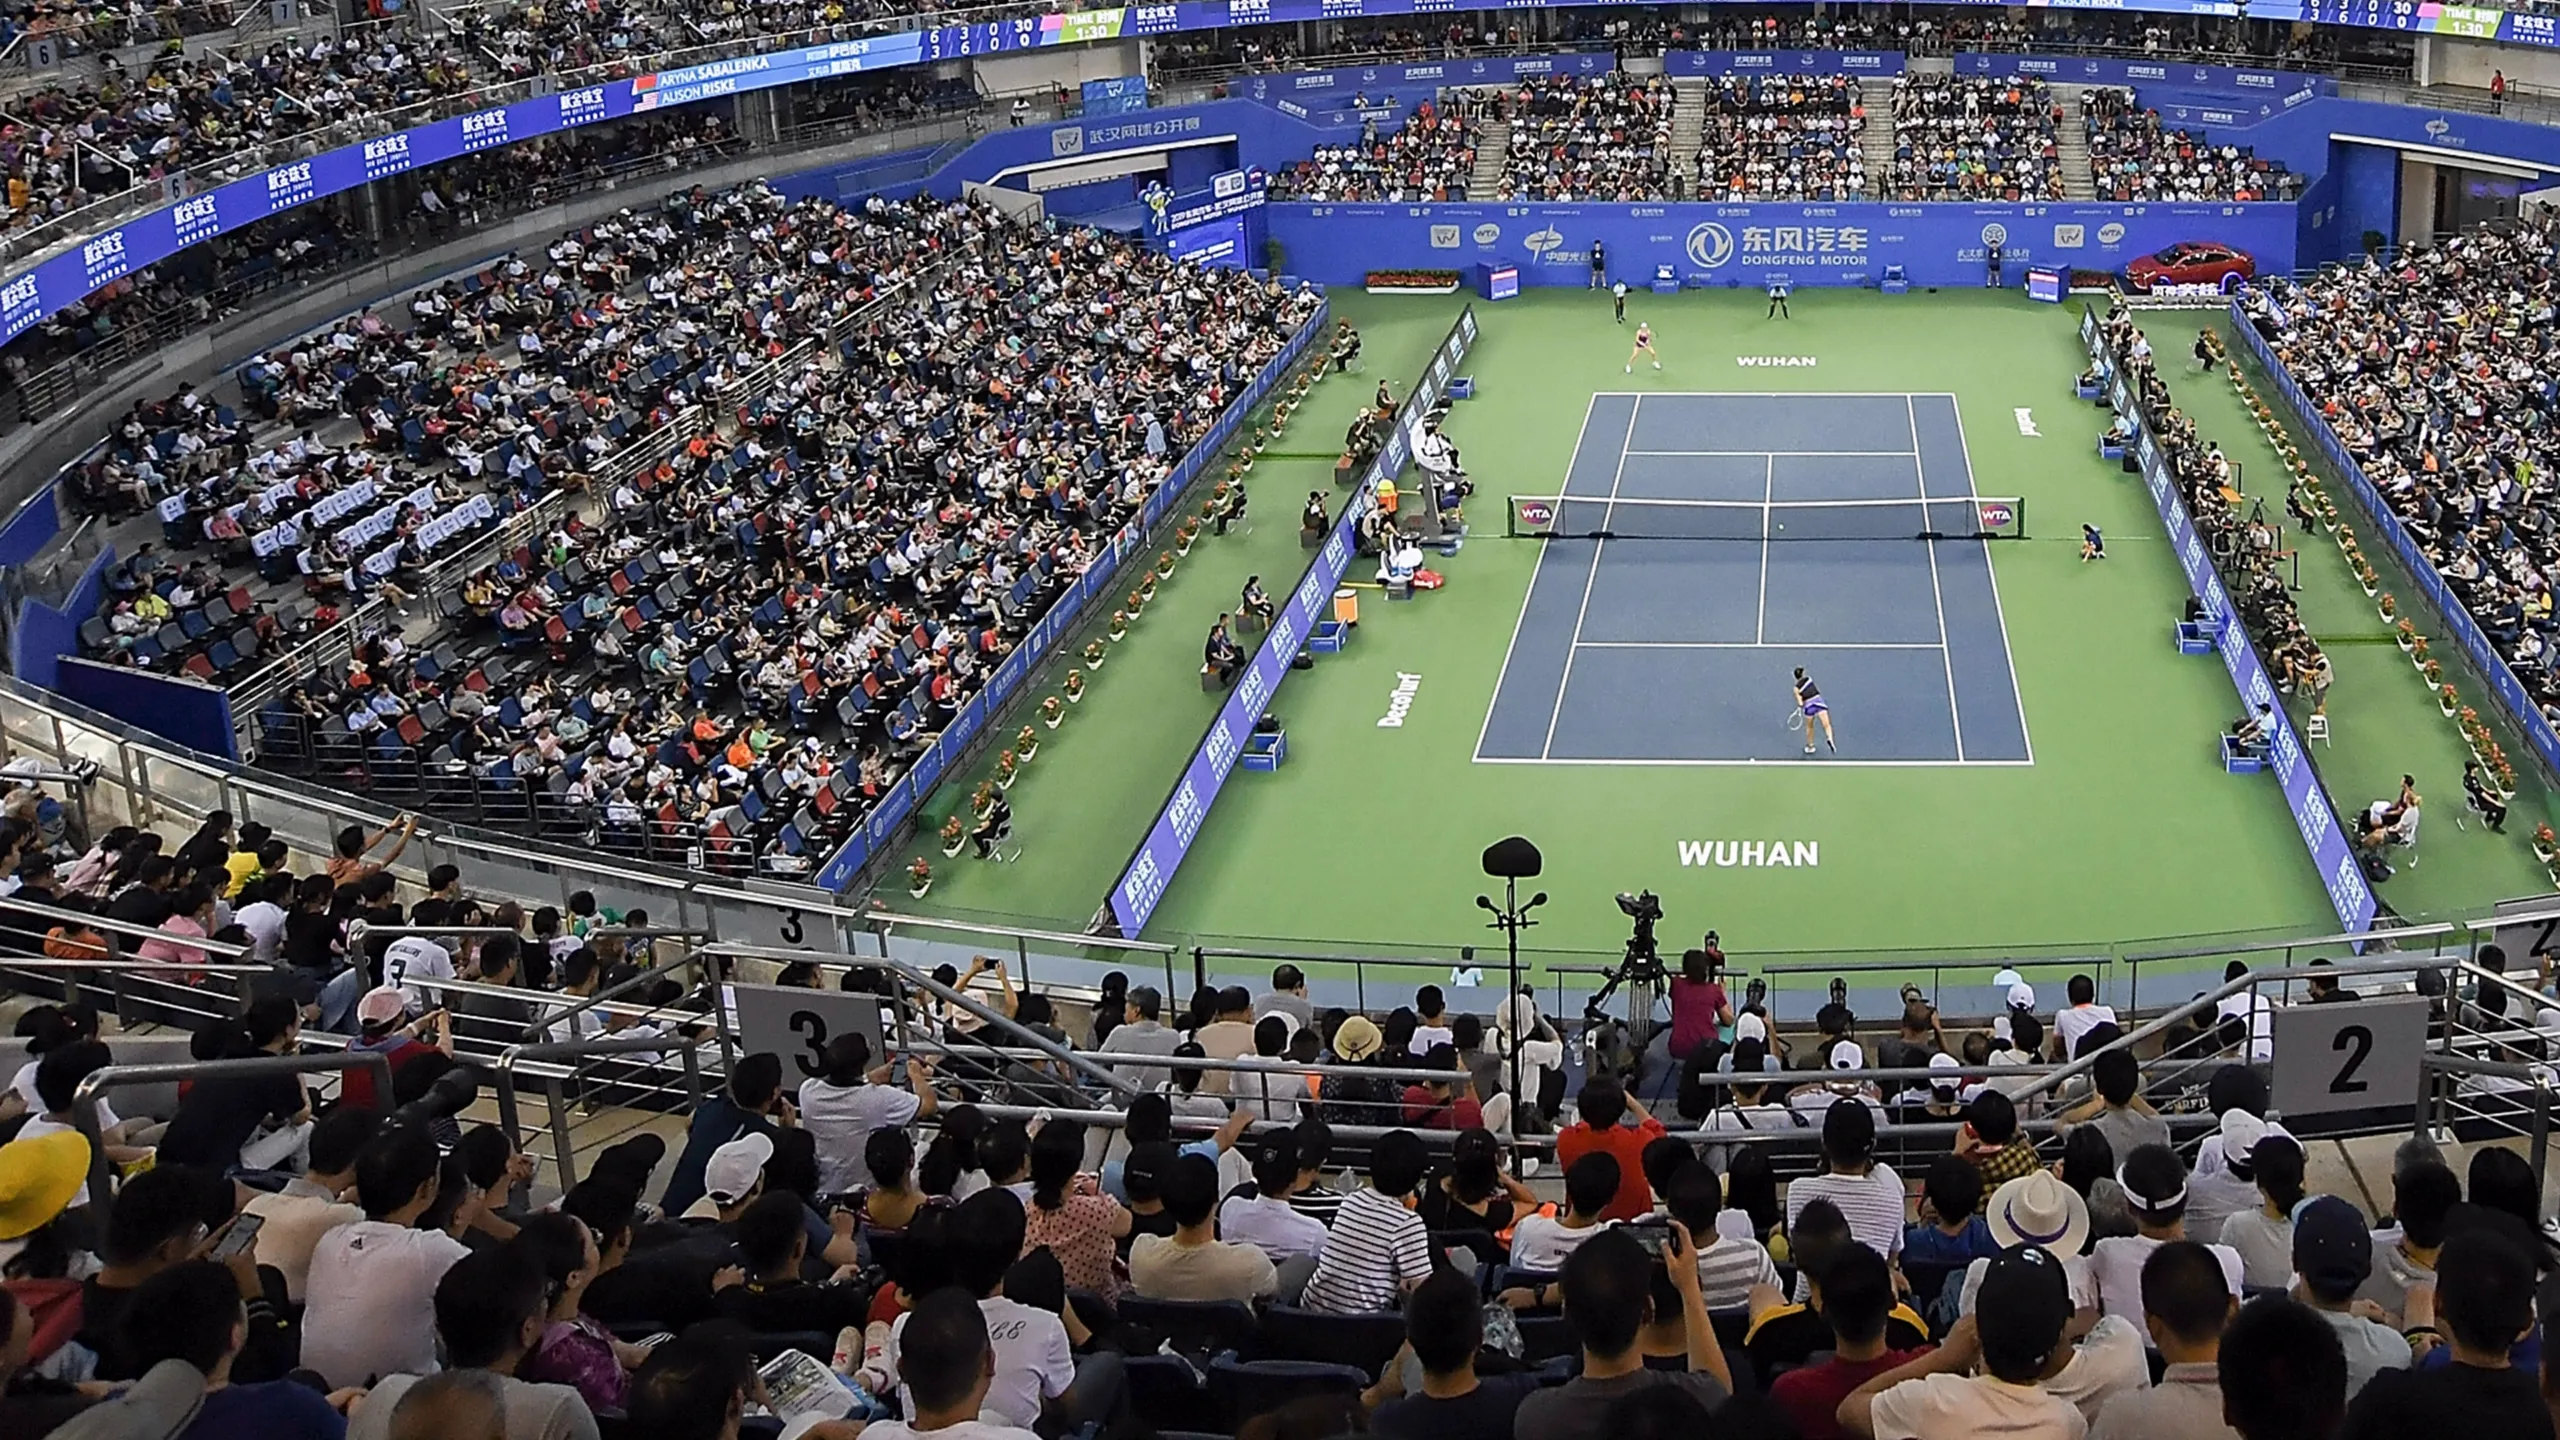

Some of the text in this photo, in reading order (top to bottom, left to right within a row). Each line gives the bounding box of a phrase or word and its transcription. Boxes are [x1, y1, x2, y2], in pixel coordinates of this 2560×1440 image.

[281, 4, 288, 19] 7
[2368, 0, 2377, 12] 0
[2393, 2, 2411, 15] 30
[2310, 9, 2319, 21] 3
[2339, 11, 2348, 23] 6
[2444, 6, 2472, 20] TIME
[907, 18, 913, 30] 8
[1015, 20, 1033, 32] 30
[1067, 14, 1095, 26] TIME
[2368, 14, 2377, 26] 0
[2398, 16, 2407, 28] 0
[960, 27, 969, 39] 3
[989, 24, 998, 36] 0
[1076, 26, 1107, 40] 1:30
[2452, 22, 2484, 35] 1:30
[930, 30, 939, 42] 6
[1020, 34, 1030, 46] 0
[961, 42, 970, 54] 6
[990, 38, 999, 50] 0
[40, 45, 49, 64] 6
[930, 46, 940, 59] 3
[659, 56, 770, 87] ARYNA SABALENKA
[662, 78, 736, 104] ALISON RISKE
[1089, 117, 1200, 144] 武汉网球公开赛
[172, 179, 181, 199] 6
[1475, 230, 1498, 238] WTA
[1742, 227, 1868, 251] 东风汽车
[2101, 229, 2123, 237] WTA
[1742, 255, 1868, 265] DONGFENG MOTOR
[1736, 356, 1816, 367] WUHAN
[1521, 508, 1551, 519] WTA
[1981, 511, 2011, 520] WTA
[1678, 841, 1819, 868] WUHAN
[778, 906, 803, 944] 3
[2530, 917, 2556, 957] 2
[788, 1010, 828, 1078] 3
[2329, 1025, 2373, 1094] 2
